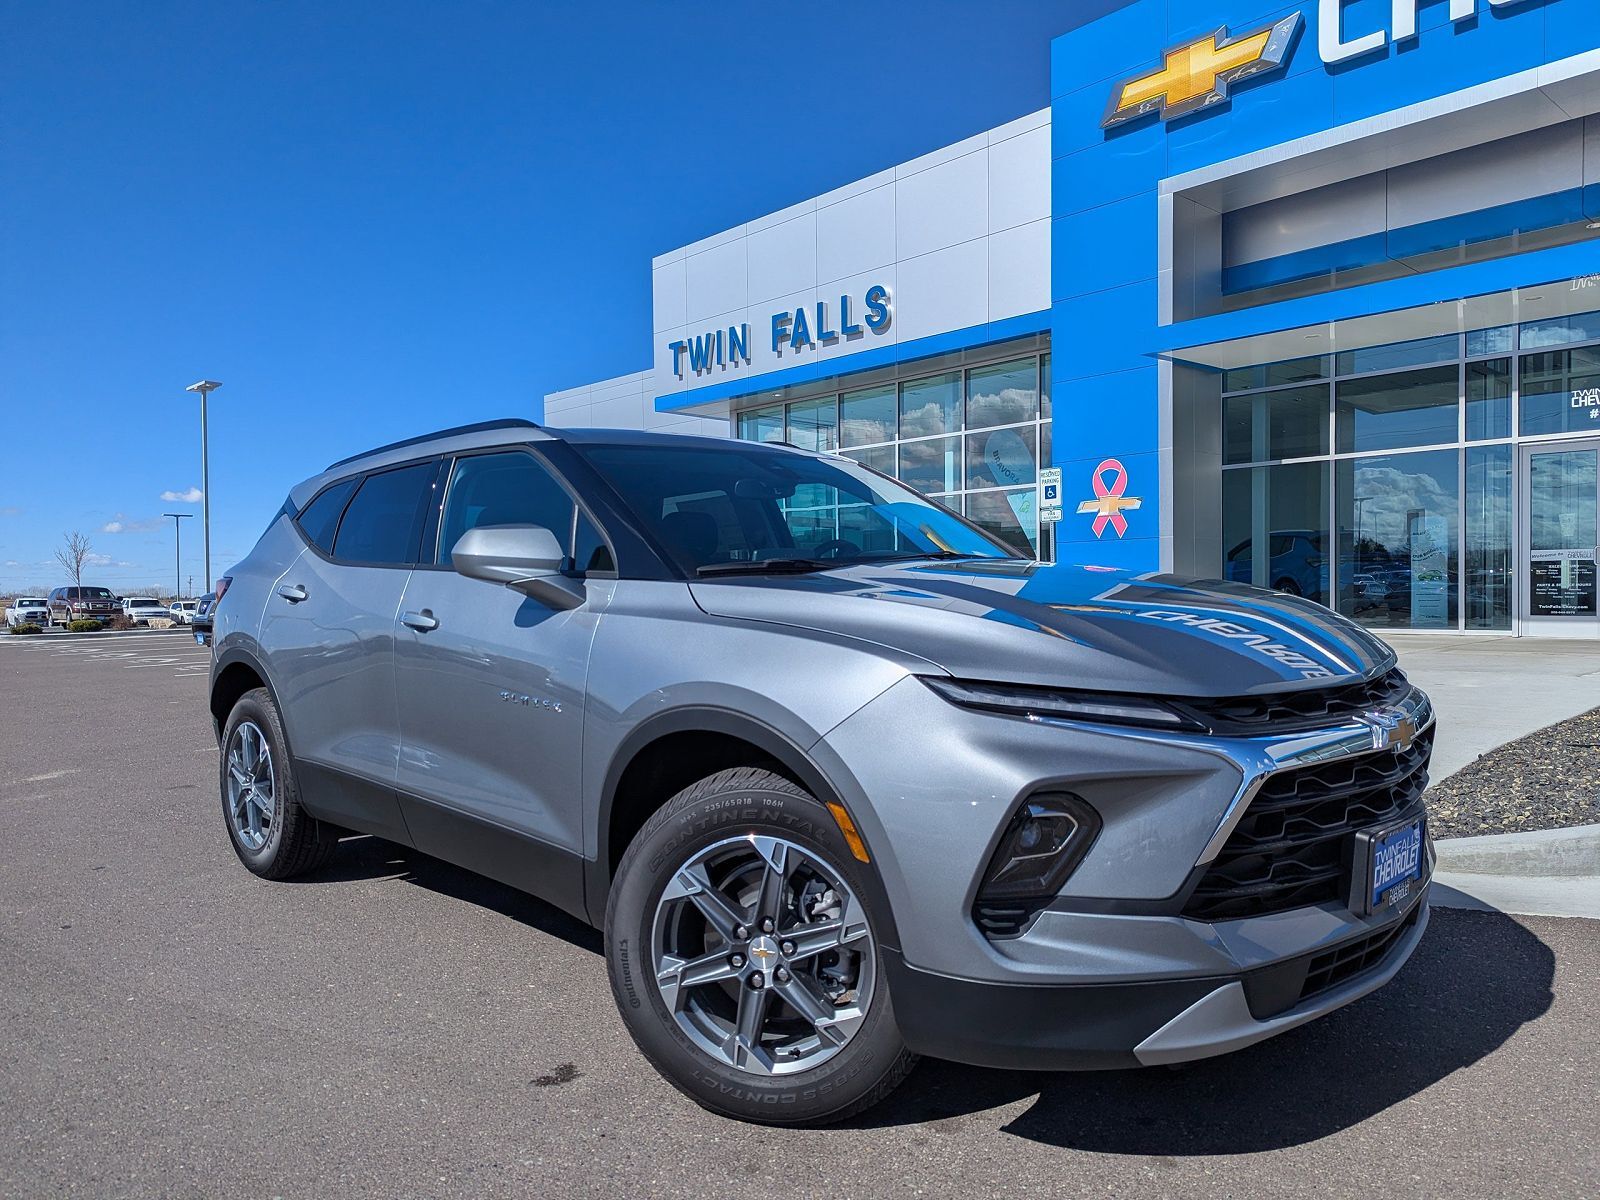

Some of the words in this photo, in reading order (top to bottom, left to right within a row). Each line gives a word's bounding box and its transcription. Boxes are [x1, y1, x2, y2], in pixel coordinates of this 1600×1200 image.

[669, 323, 751, 377] TWIN
[772, 285, 892, 354] FALLS
[704, 797, 752, 813] 235/65R18
[762, 798, 784, 808] 106H
[649, 808, 830, 873] CONTINENTAL
[1374, 844, 1420, 889] CHEVROLET
[619, 947, 641, 1009] Continental
[691, 1070, 797, 1104] CONTACT
